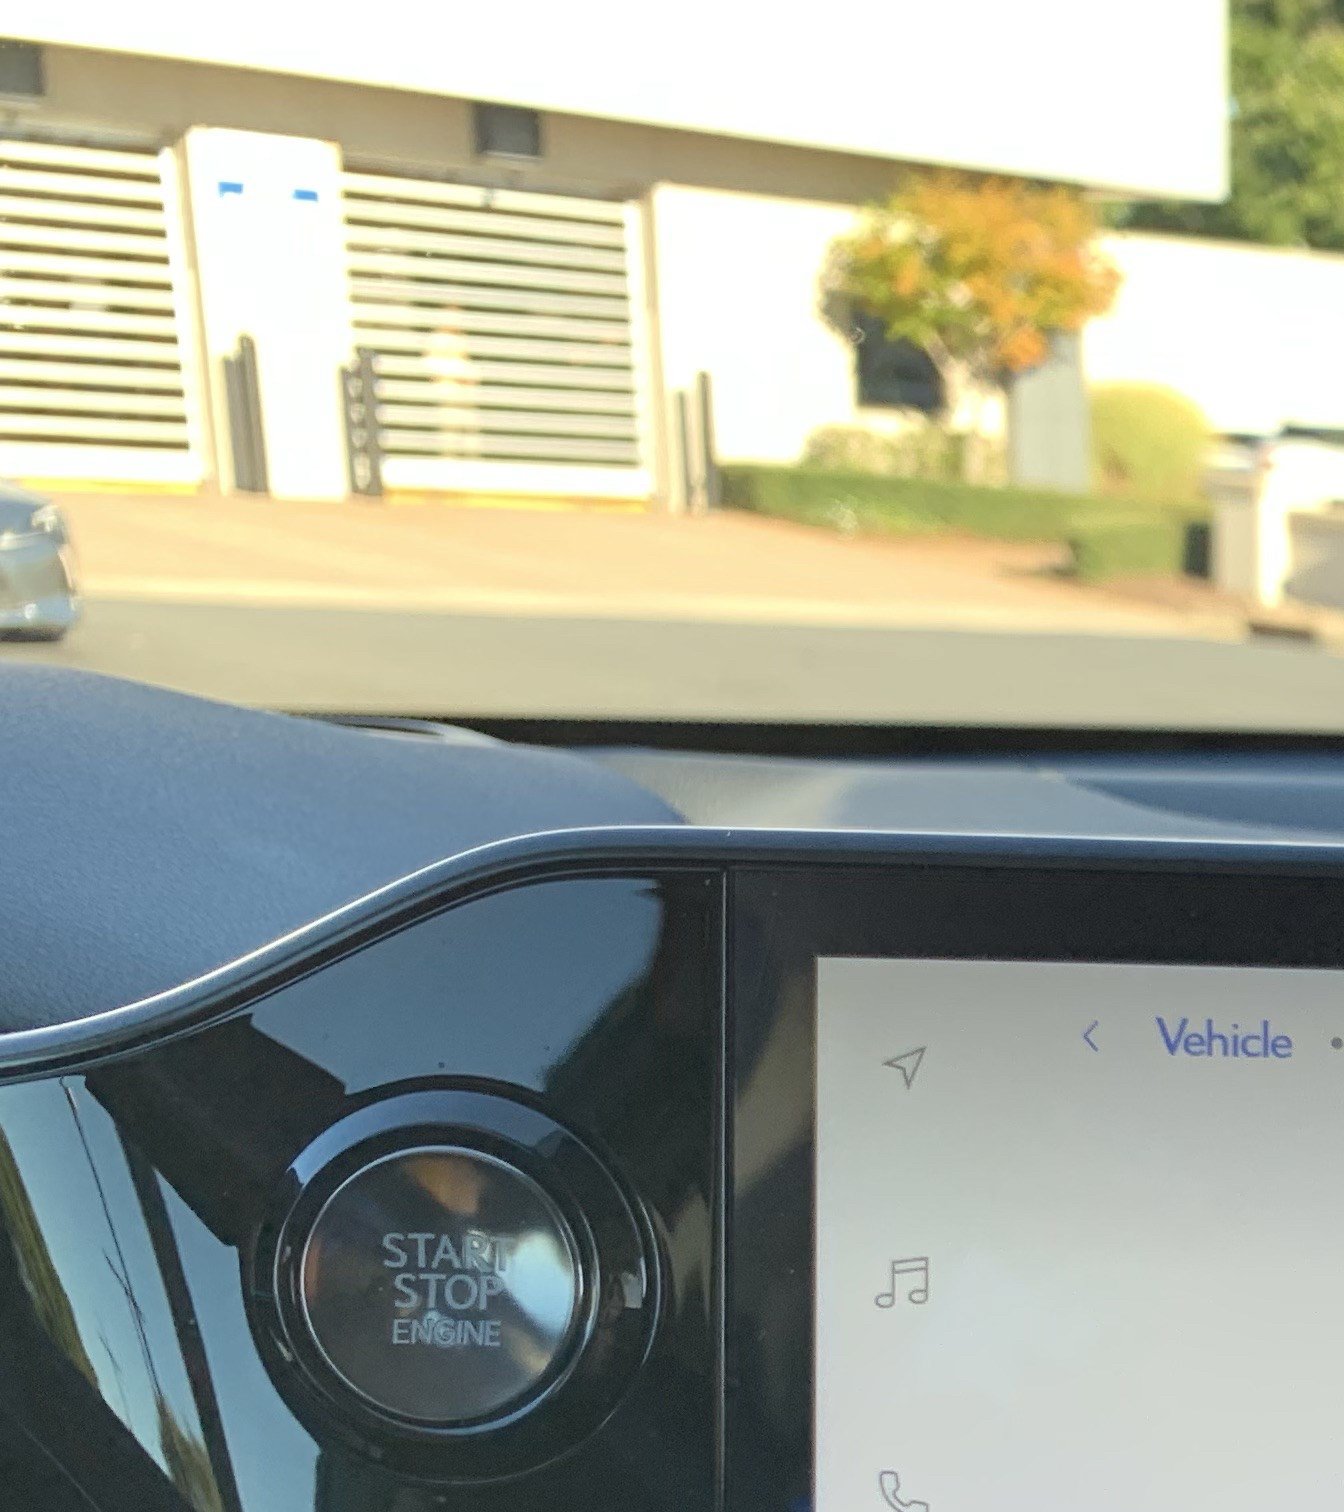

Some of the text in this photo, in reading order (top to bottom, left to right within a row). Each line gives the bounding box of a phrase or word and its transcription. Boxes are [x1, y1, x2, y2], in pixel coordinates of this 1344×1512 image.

[1156, 1017, 1292, 1058] Vehicle
[382, 1231, 515, 1272] START
[395, 1273, 505, 1311] STOP
[394, 1318, 501, 1347] ENGINE
